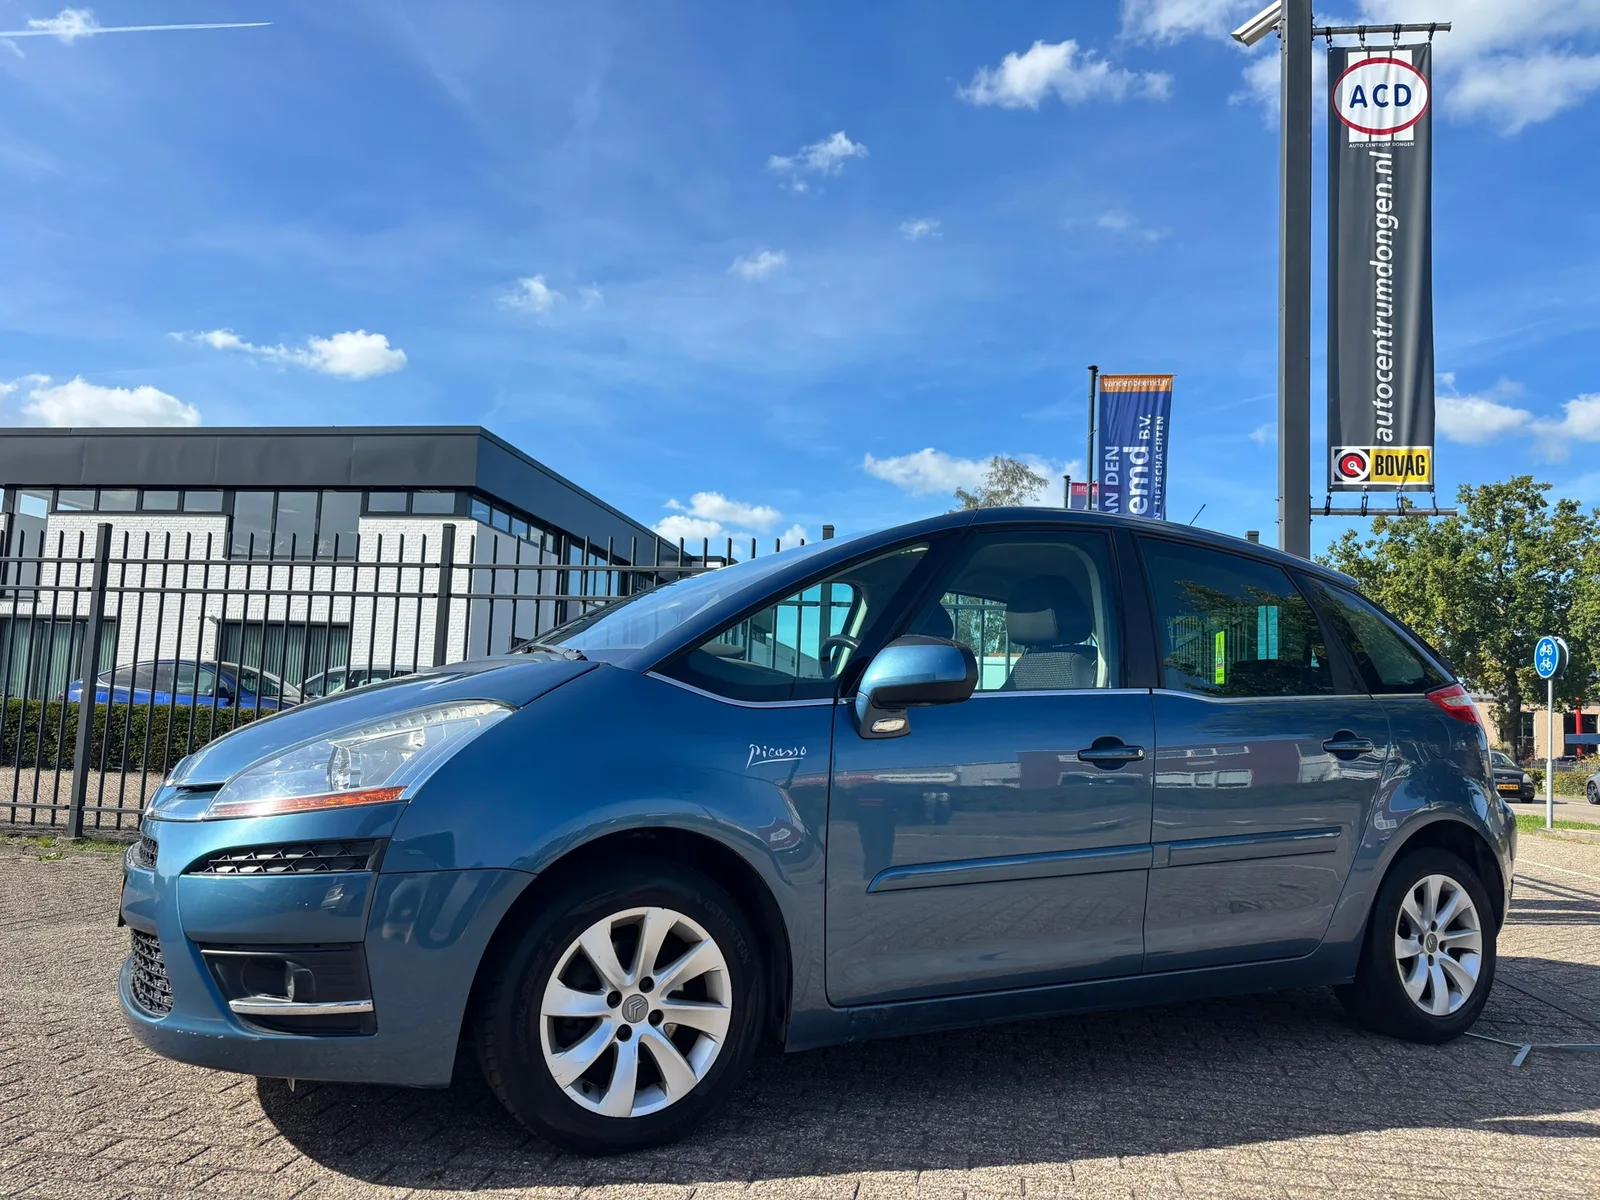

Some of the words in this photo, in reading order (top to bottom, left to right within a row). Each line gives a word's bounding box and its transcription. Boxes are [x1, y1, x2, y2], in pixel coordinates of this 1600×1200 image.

[1349, 83, 1412, 109] ACD
[1369, 151, 1399, 443] autocentrumdongen.nl
[1138, 414, 1152, 440] B.V.
[1105, 446, 1119, 486] DEN
[1154, 416, 1164, 505] LIFTSCHACHTEN
[1374, 454, 1427, 477] BOVAG
[746, 743, 807, 770] Picasso
